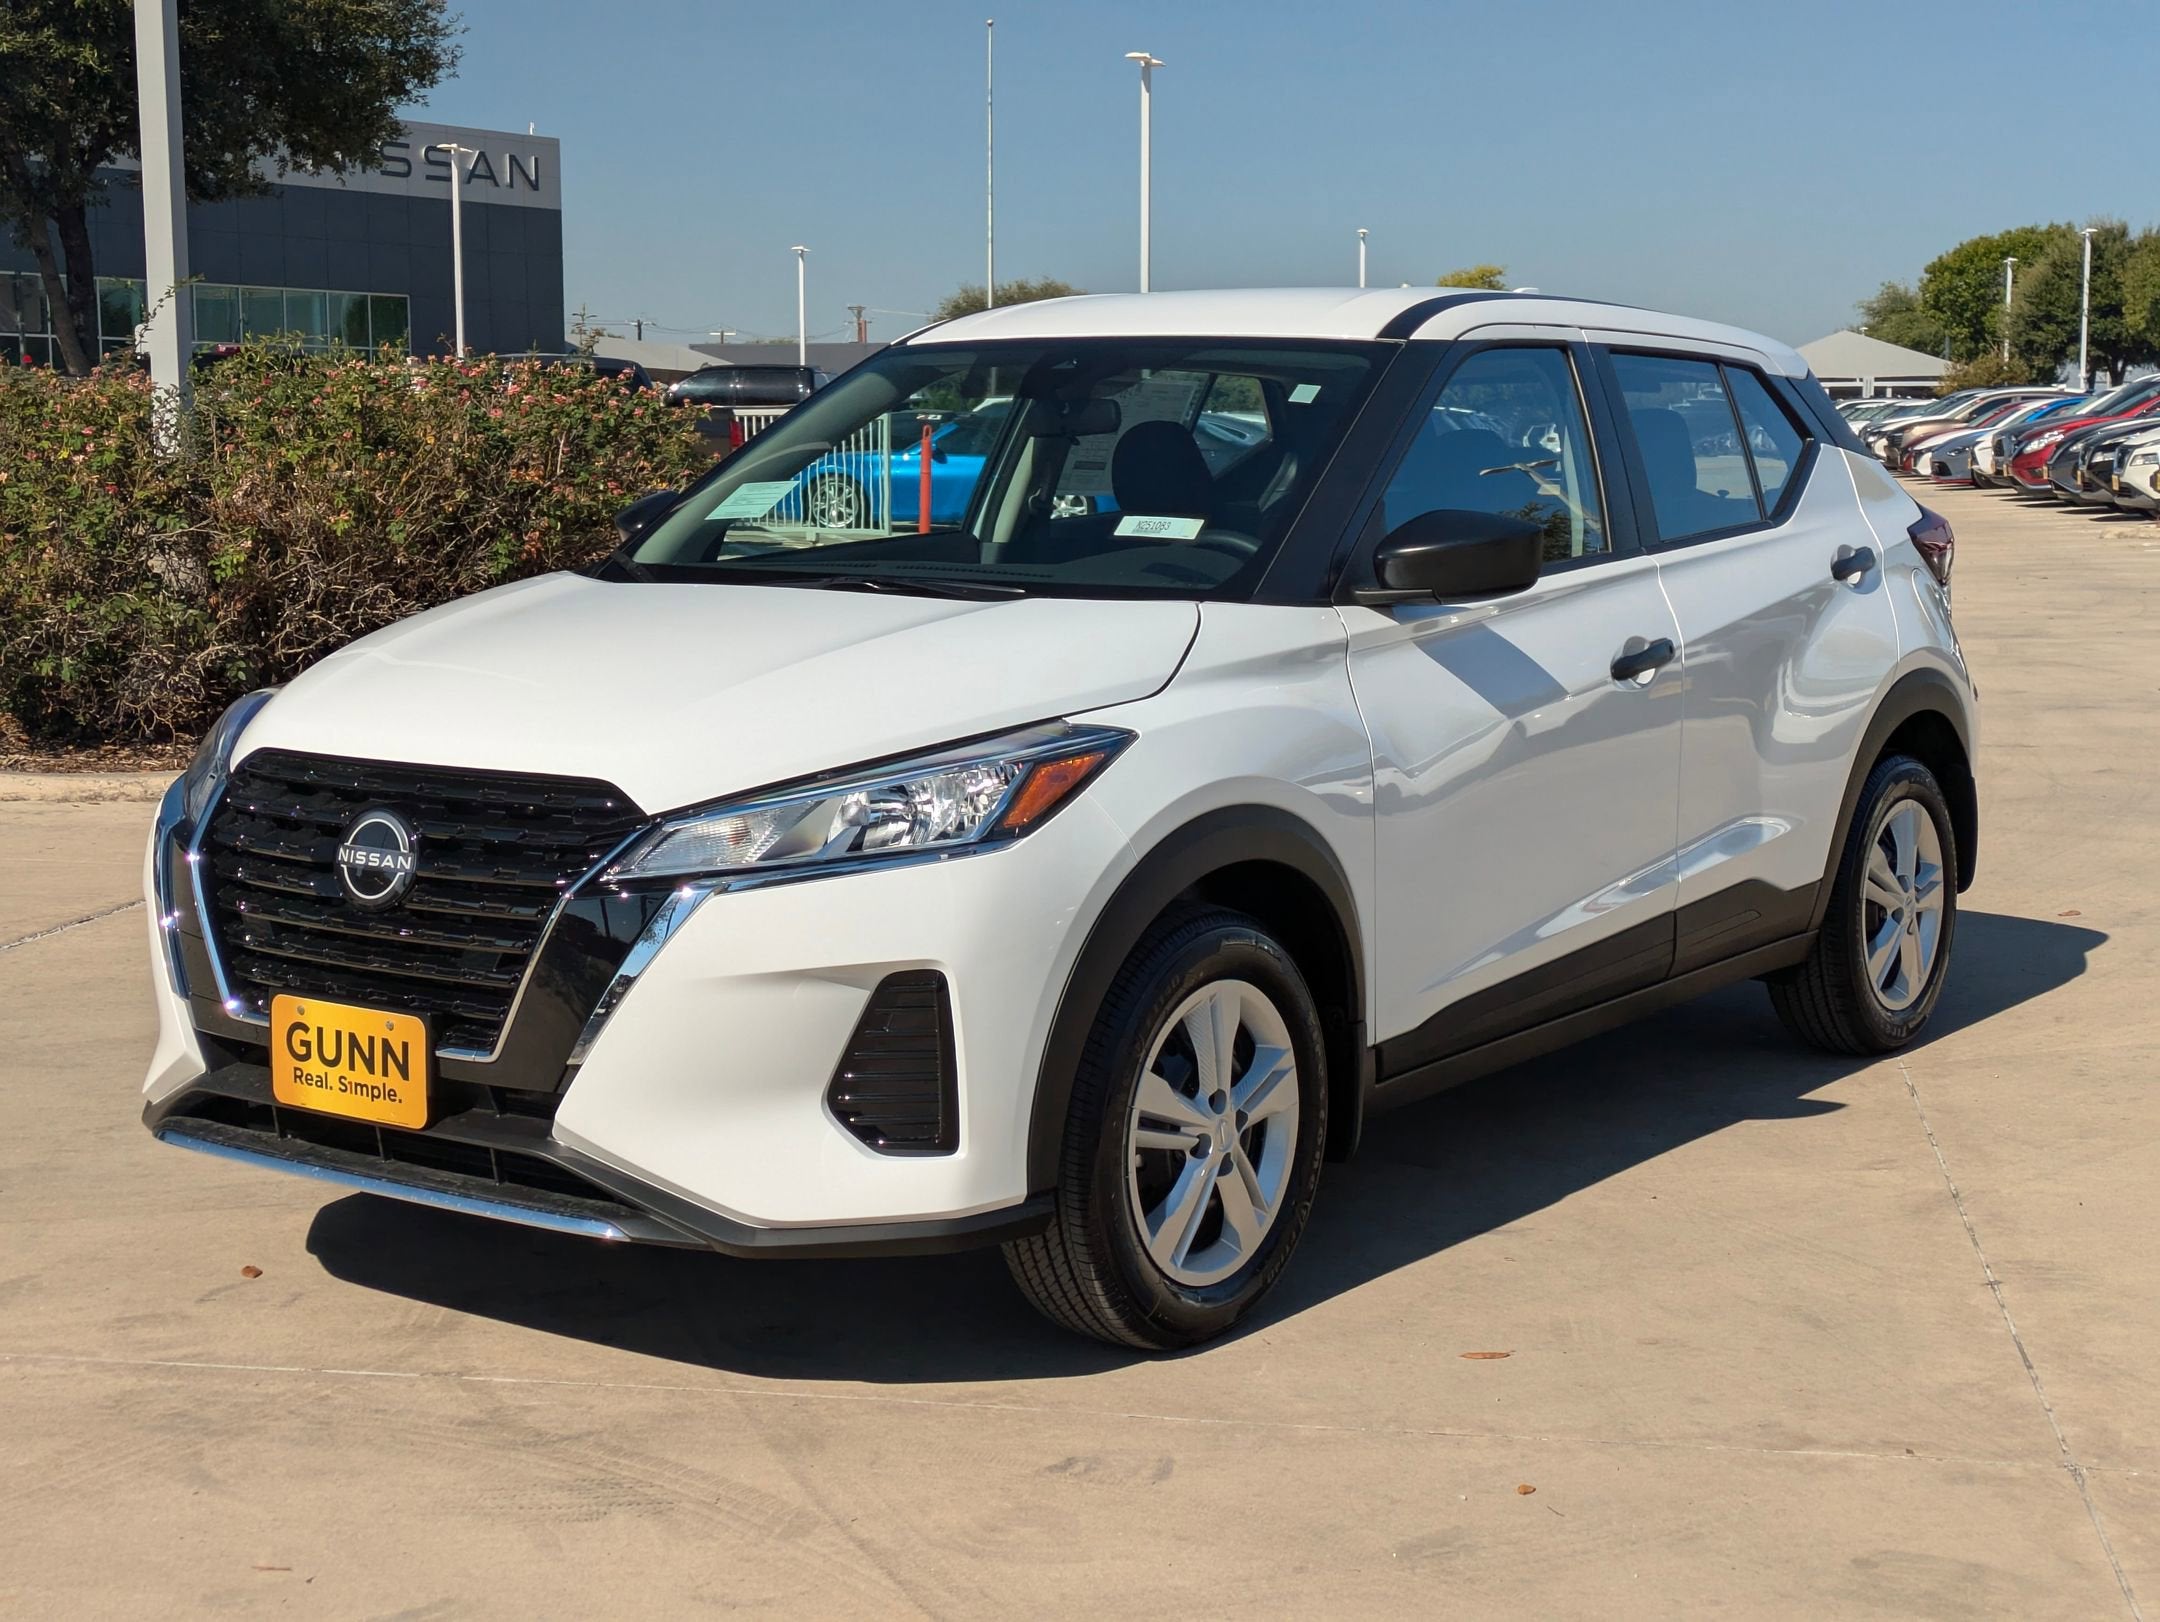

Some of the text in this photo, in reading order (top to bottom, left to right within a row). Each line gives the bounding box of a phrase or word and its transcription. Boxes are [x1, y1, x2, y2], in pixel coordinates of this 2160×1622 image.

[336, 140, 540, 192] SSAN
[338, 847, 412, 870] NISSAN
[286, 1021, 410, 1081] GUNN
[293, 1066, 333, 1091] Real.
